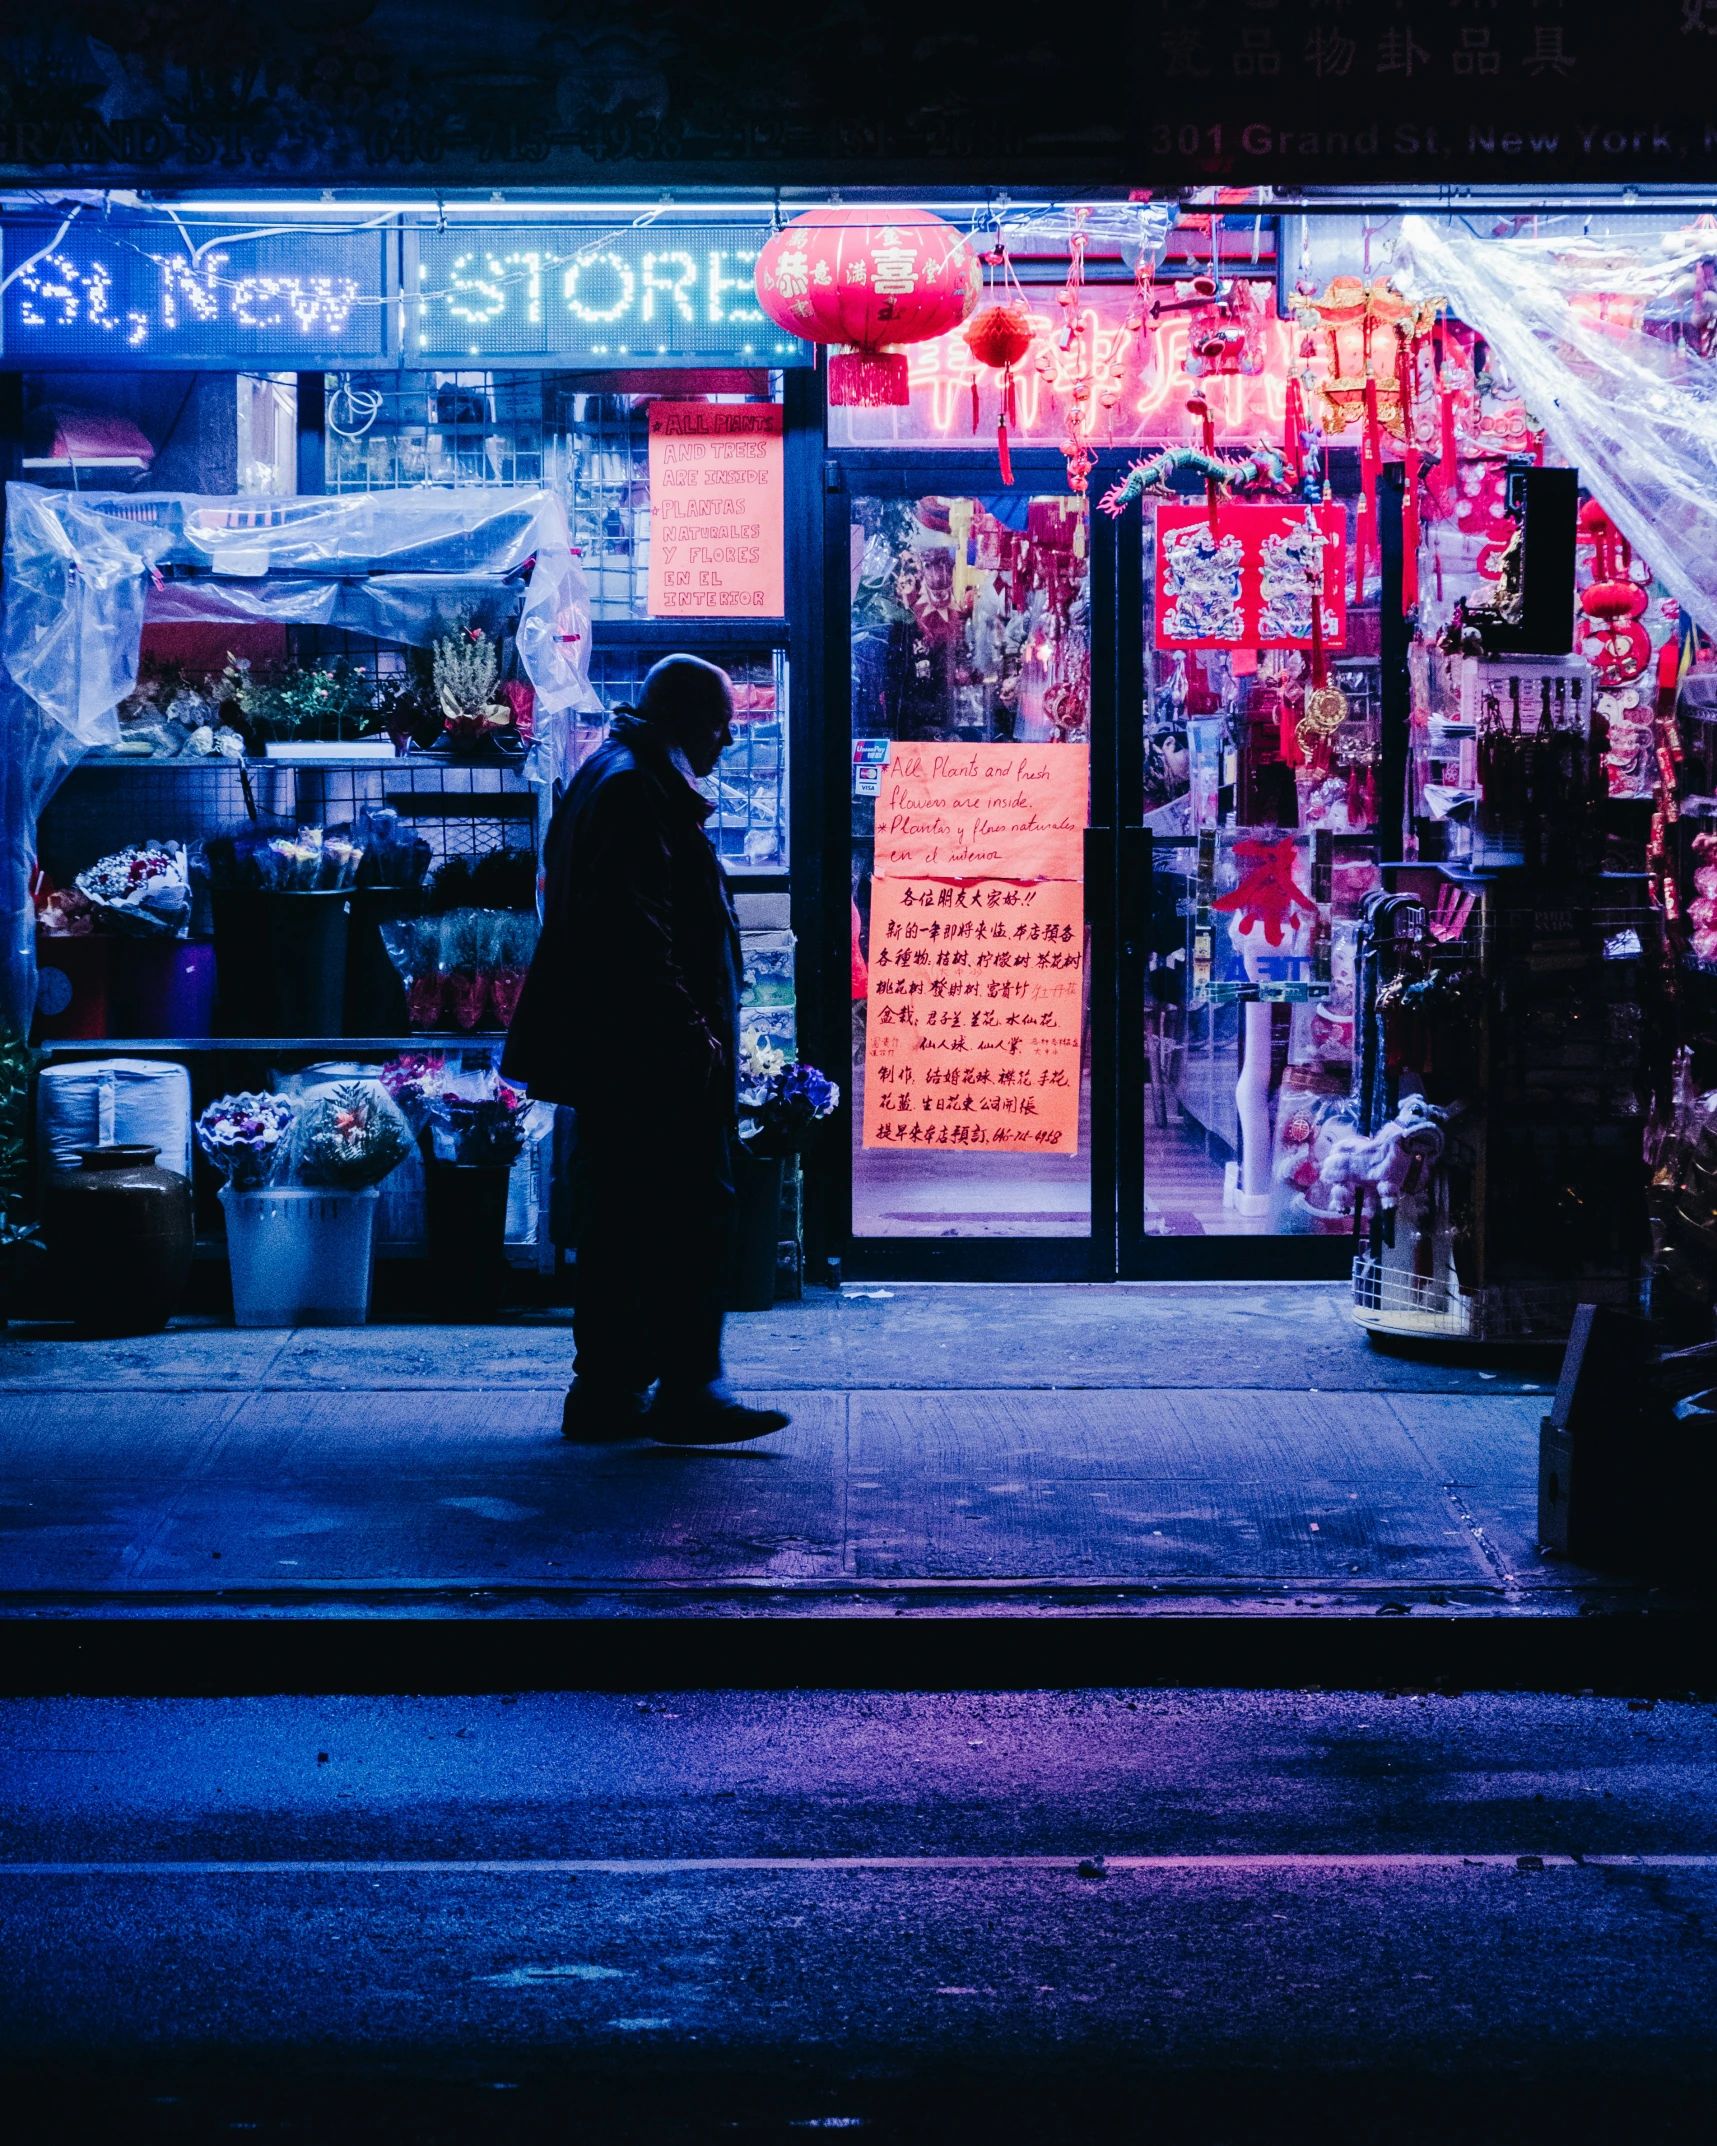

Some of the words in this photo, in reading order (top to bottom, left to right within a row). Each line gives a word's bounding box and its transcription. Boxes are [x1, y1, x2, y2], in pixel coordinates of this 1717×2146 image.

[1151, 123, 1222, 157] 301
[1240, 122, 1381, 157] Grand
[1393, 123, 1453, 161] St,
[1468, 124, 1560, 156] New
[1576, 124, 1689, 161] York,
[446, 251, 764, 324] STORE
[665, 414, 709, 436] ALL
[663, 443, 706, 465] AND
[711, 441, 767, 459] TREES
[663, 469, 698, 486] ARE
[704, 469, 769, 485] INSIDE
[662, 498, 746, 520] PLANTAS
[663, 546, 677, 565] Y
[689, 546, 760, 564] FLORES
[664, 571, 690, 586] EN
[699, 571, 723, 587] EL
[664, 591, 765, 607] INTERIOR
[890, 756, 923, 779] All
[932, 753, 978, 779] Plants
[985, 761, 1013, 777] and
[953, 799, 979, 808] are
[890, 814, 951, 835] Plantas
[957, 827, 964, 844] y
[1011, 814, 1076, 832] naturales
[890, 849, 913, 862] en
[925, 846, 938, 864] el
[948, 848, 1002, 863] interior
